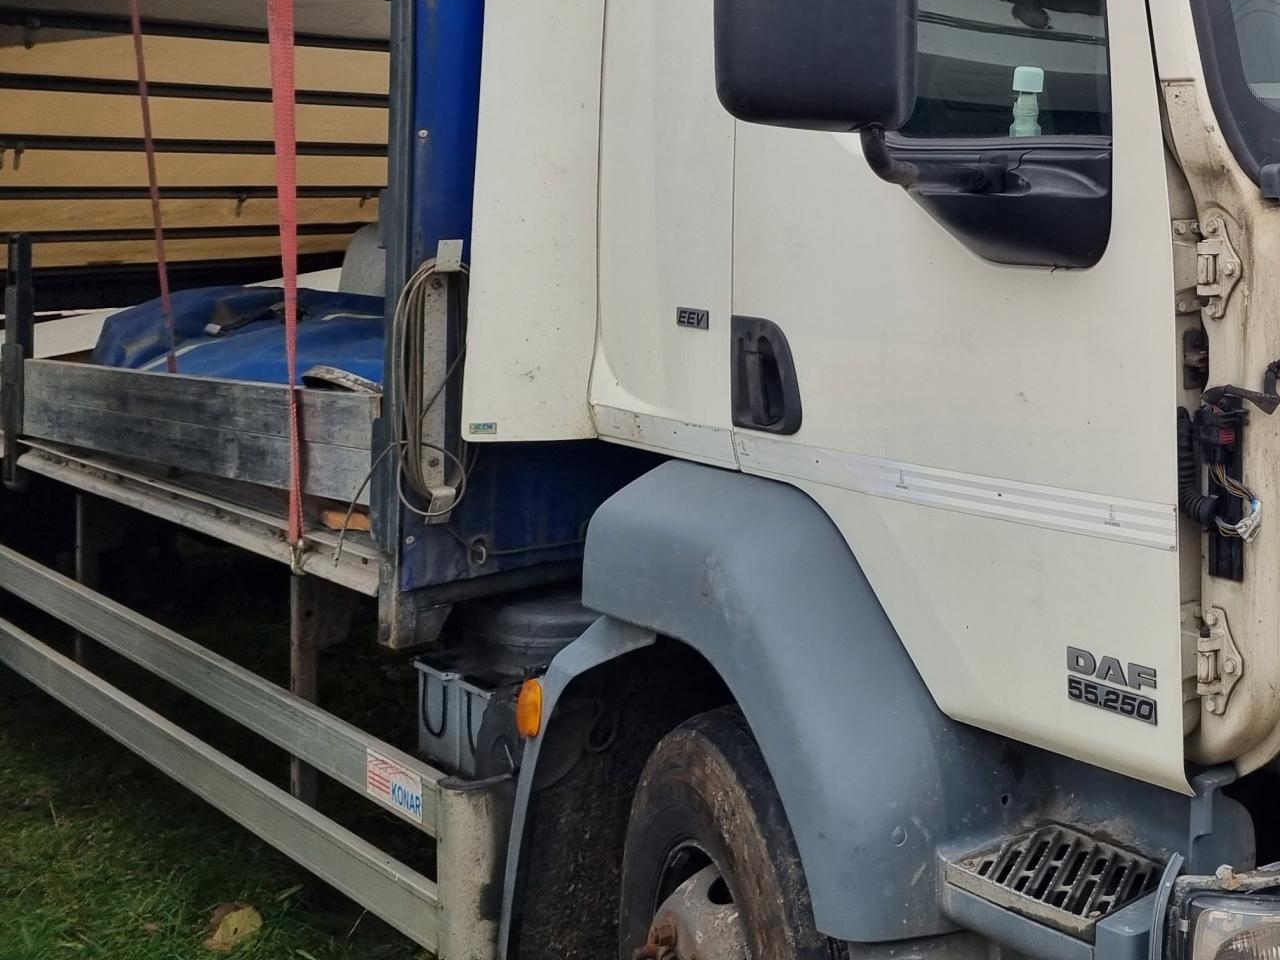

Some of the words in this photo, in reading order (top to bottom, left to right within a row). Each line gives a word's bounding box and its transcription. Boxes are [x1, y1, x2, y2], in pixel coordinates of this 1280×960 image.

[678, 309, 705, 327] EEV
[1066, 645, 1157, 691] DAF
[1067, 677, 1155, 722] 55.250
[391, 782, 423, 818] KONAR
